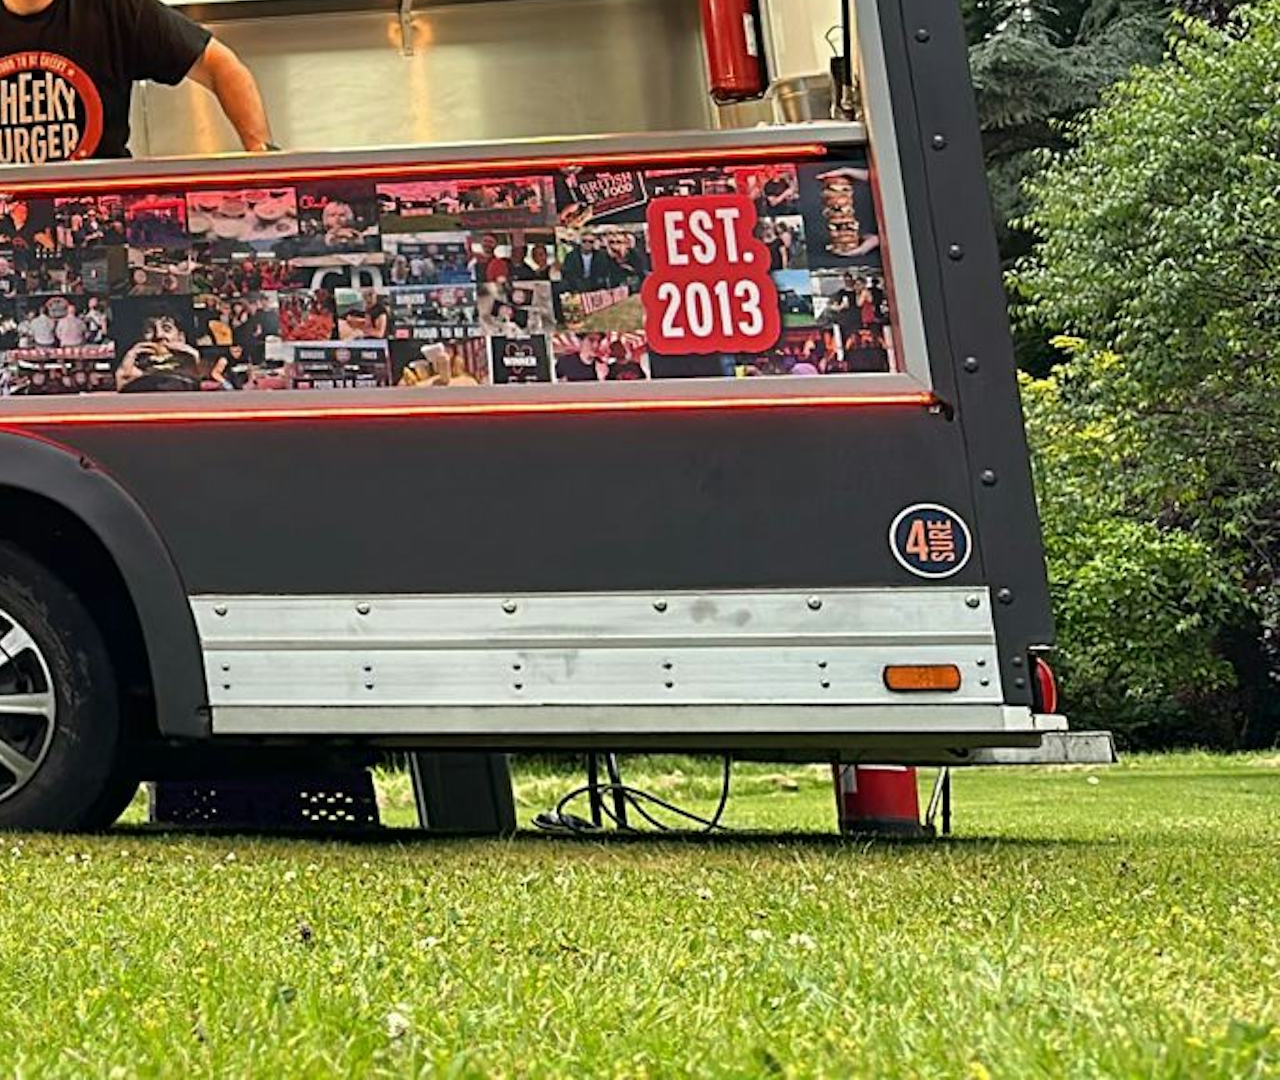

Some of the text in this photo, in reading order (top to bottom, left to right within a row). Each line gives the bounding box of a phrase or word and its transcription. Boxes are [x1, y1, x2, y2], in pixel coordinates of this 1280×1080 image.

[664, 207, 754, 266] EST.
[657, 280, 764, 338] 2013
[905, 519, 955, 562] 4 SURE
